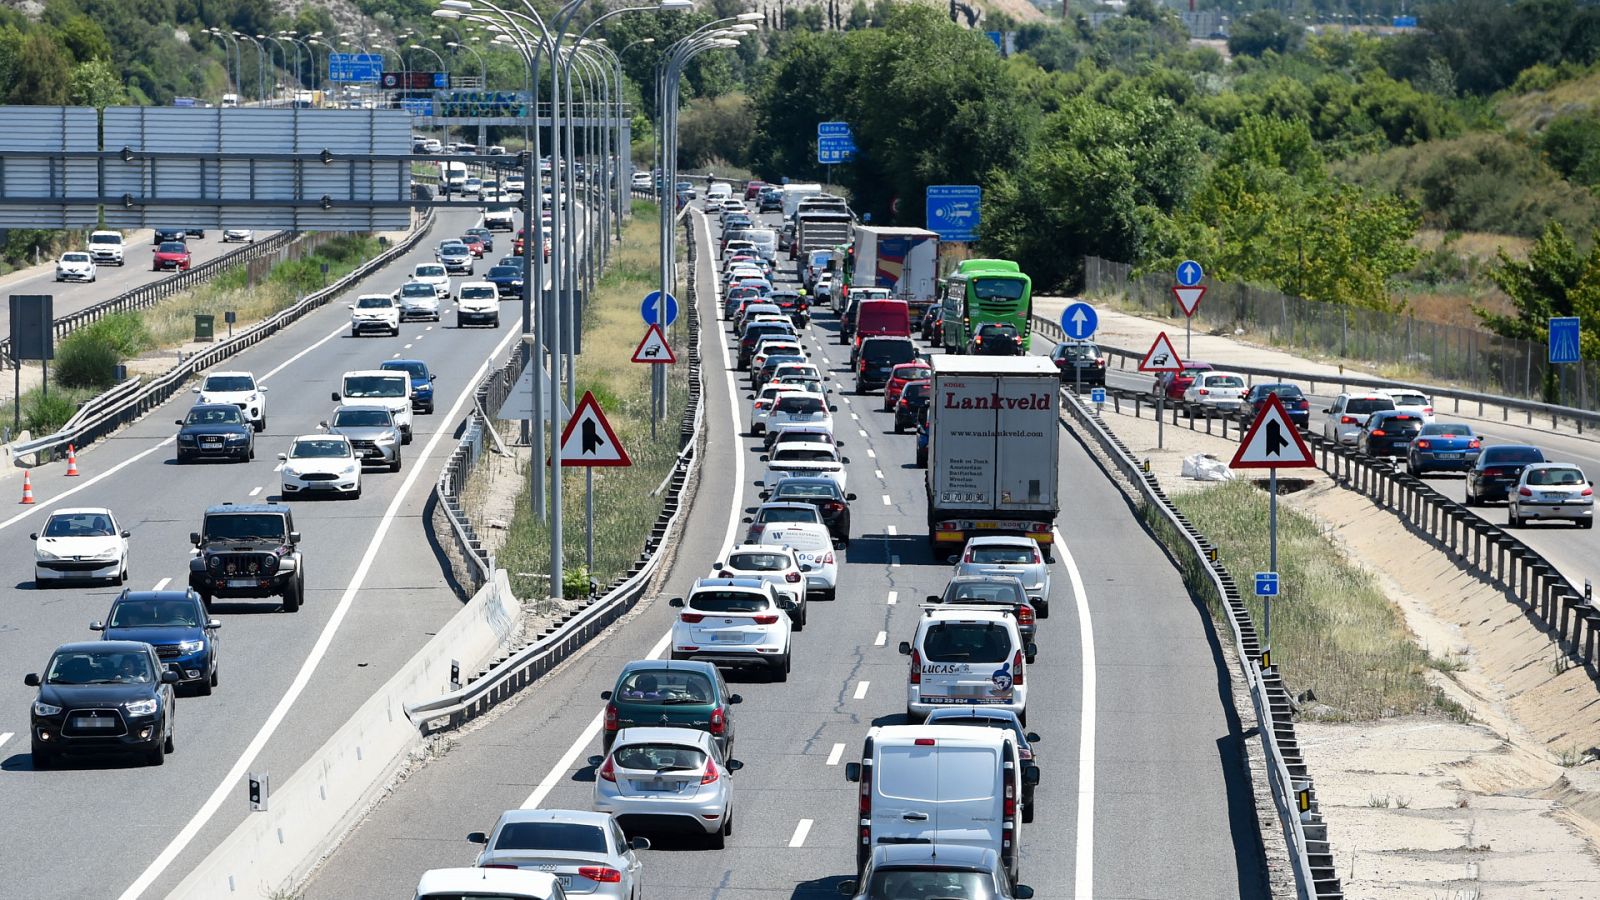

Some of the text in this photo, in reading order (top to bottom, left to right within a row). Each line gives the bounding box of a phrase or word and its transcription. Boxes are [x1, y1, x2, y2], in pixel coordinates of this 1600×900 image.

[944, 391, 1051, 410] Lankveld
[950, 430, 1043, 438] www.vanlankveld.com
[942, 492, 951, 501] 60
[954, 492, 962, 501] 70
[1263, 584, 1270, 592] 4
[922, 664, 955, 674] LUCAS
